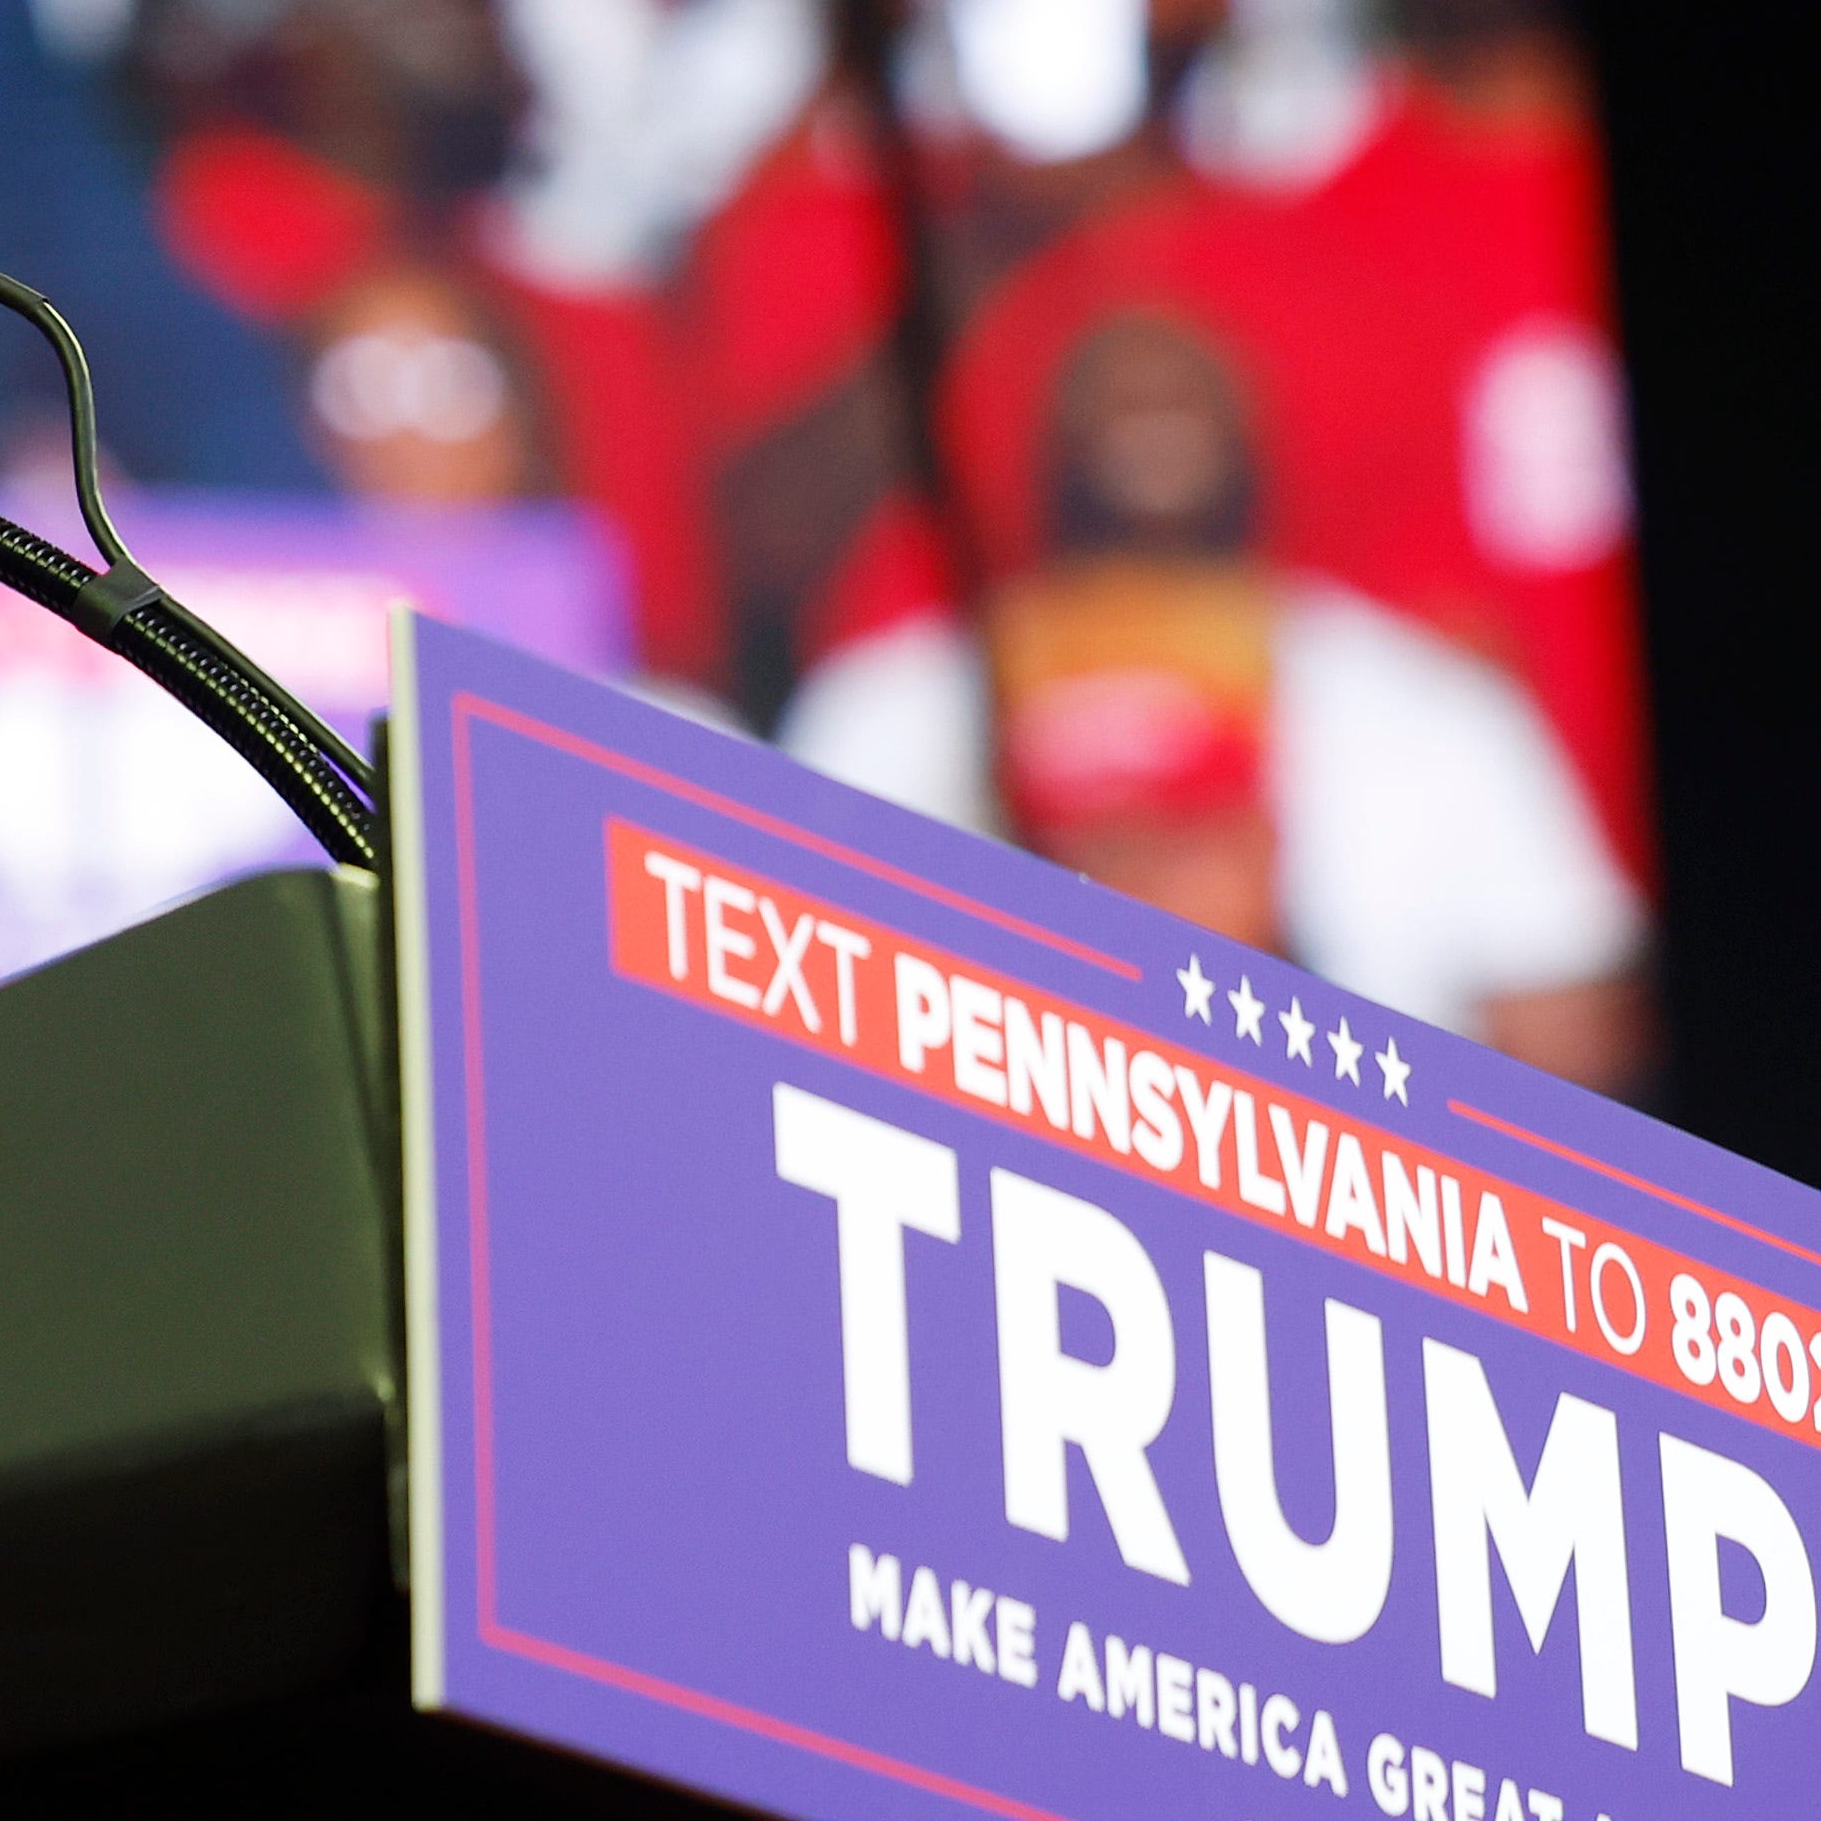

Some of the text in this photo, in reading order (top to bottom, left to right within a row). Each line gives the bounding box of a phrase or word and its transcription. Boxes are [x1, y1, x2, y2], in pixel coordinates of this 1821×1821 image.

[642, 850, 1821, 1435] TEXT PENNSYLVANIA TO 880
[771, 1081, 1818, 1788] TRUMP
[848, 1543, 1039, 1690] MAKE
[1057, 1621, 1349, 1798] AMERICA
